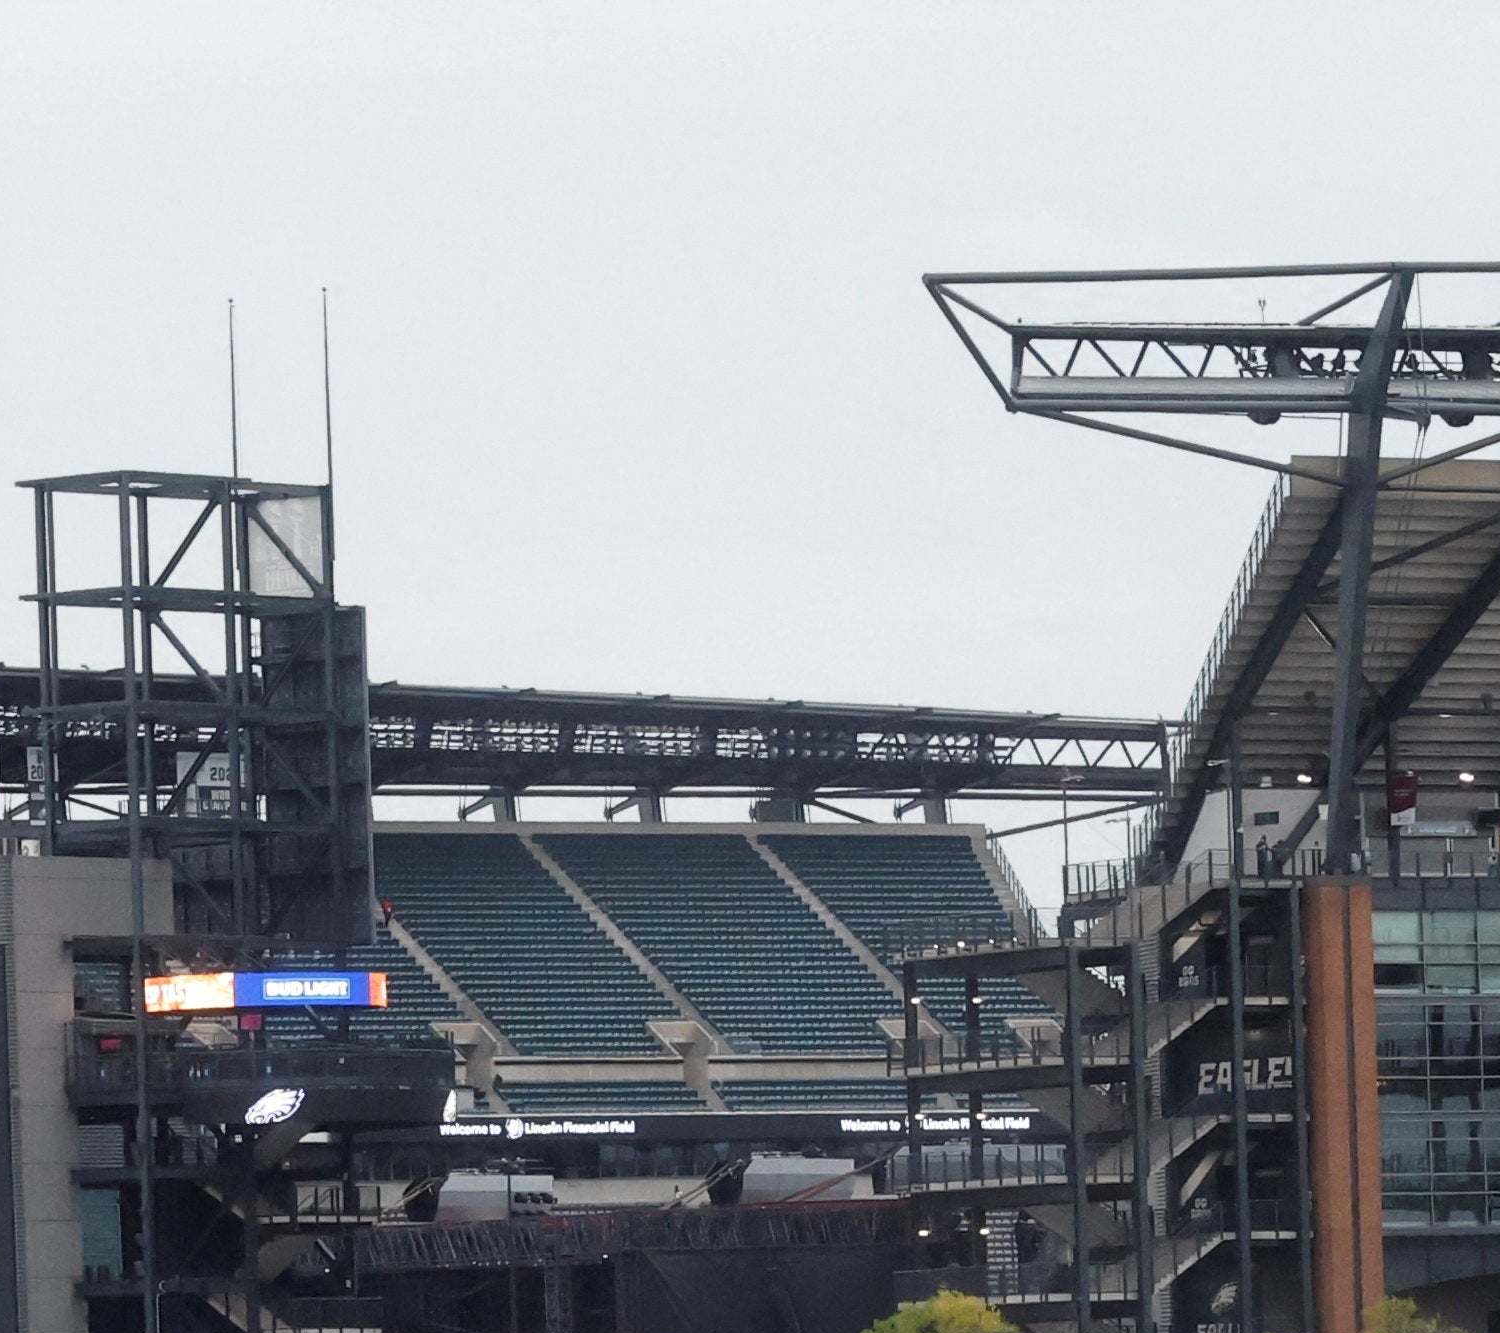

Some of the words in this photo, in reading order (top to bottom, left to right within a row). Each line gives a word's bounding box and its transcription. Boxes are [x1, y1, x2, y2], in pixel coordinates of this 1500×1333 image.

[266, 980, 303, 997] BUD
[304, 980, 349, 997] LIGHT
[440, 1123, 489, 1136] Welcome
[490, 1123, 502, 1135] to
[524, 1120, 562, 1135] Lincoln
[563, 1121, 609, 1134] Financial
[610, 1120, 636, 1134] Field
[841, 1119, 889, 1132] Welcome
[890, 1119, 902, 1131] to
[923, 1117, 960, 1130] Lincoln
[1006, 1116, 1031, 1130] Field
